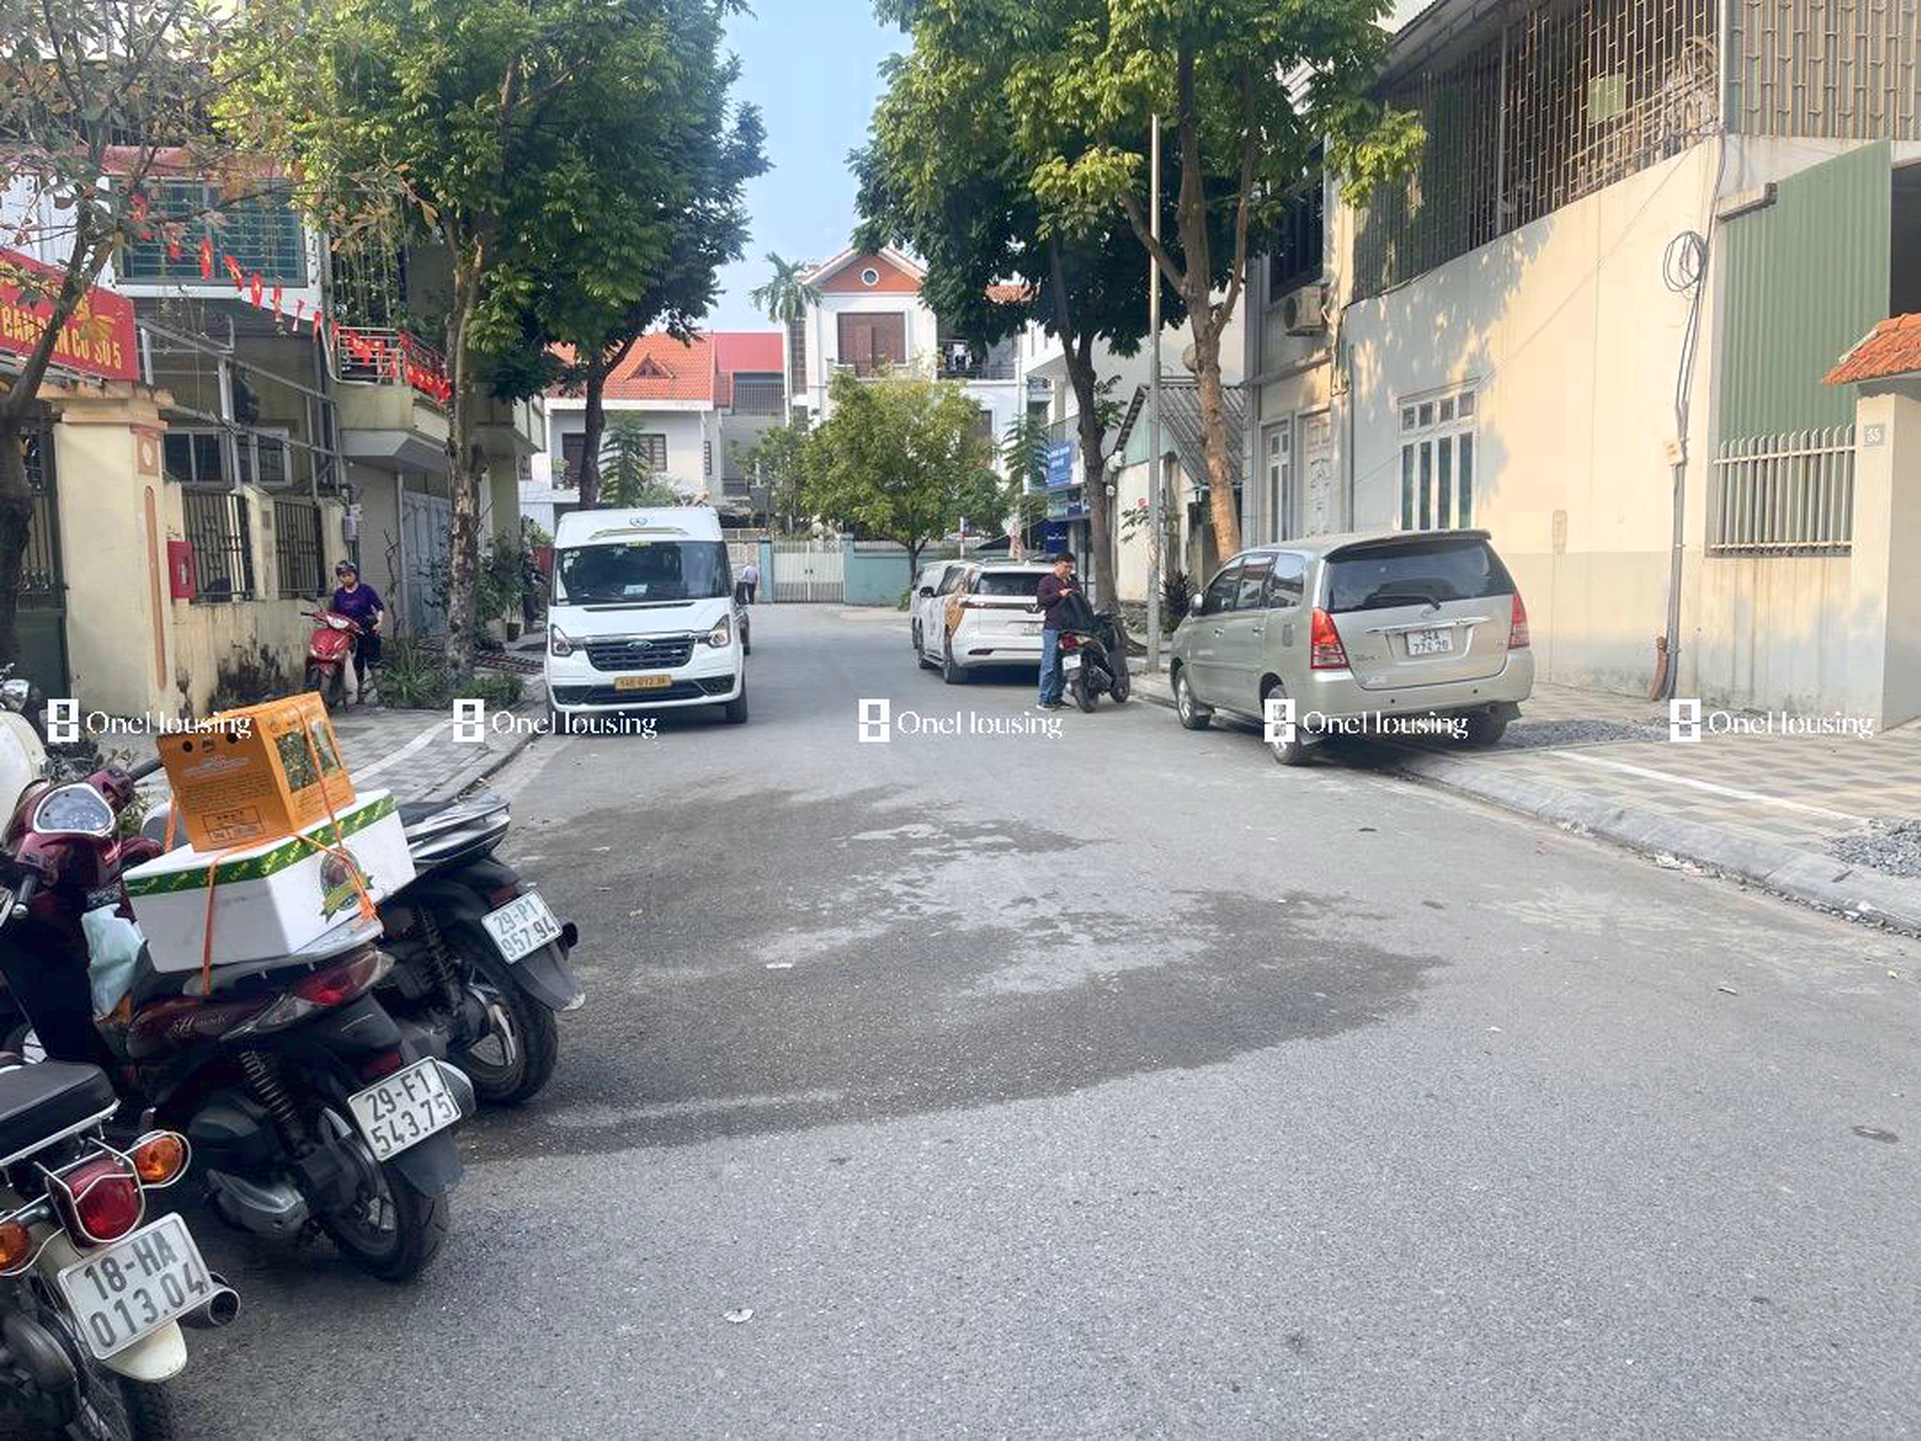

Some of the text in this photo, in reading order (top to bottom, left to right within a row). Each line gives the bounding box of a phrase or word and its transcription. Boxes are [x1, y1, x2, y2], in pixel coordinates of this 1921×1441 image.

[113, 341, 122, 370] 5
[494, 898, 538, 935] 29-P1
[500, 916, 556, 958] 957.94
[365, 1069, 431, 1122] 29-F1
[370, 1092, 453, 1153] 543.75
[84, 1231, 178, 1300] 18-HA
[89, 1263, 205, 1348] 013.04
